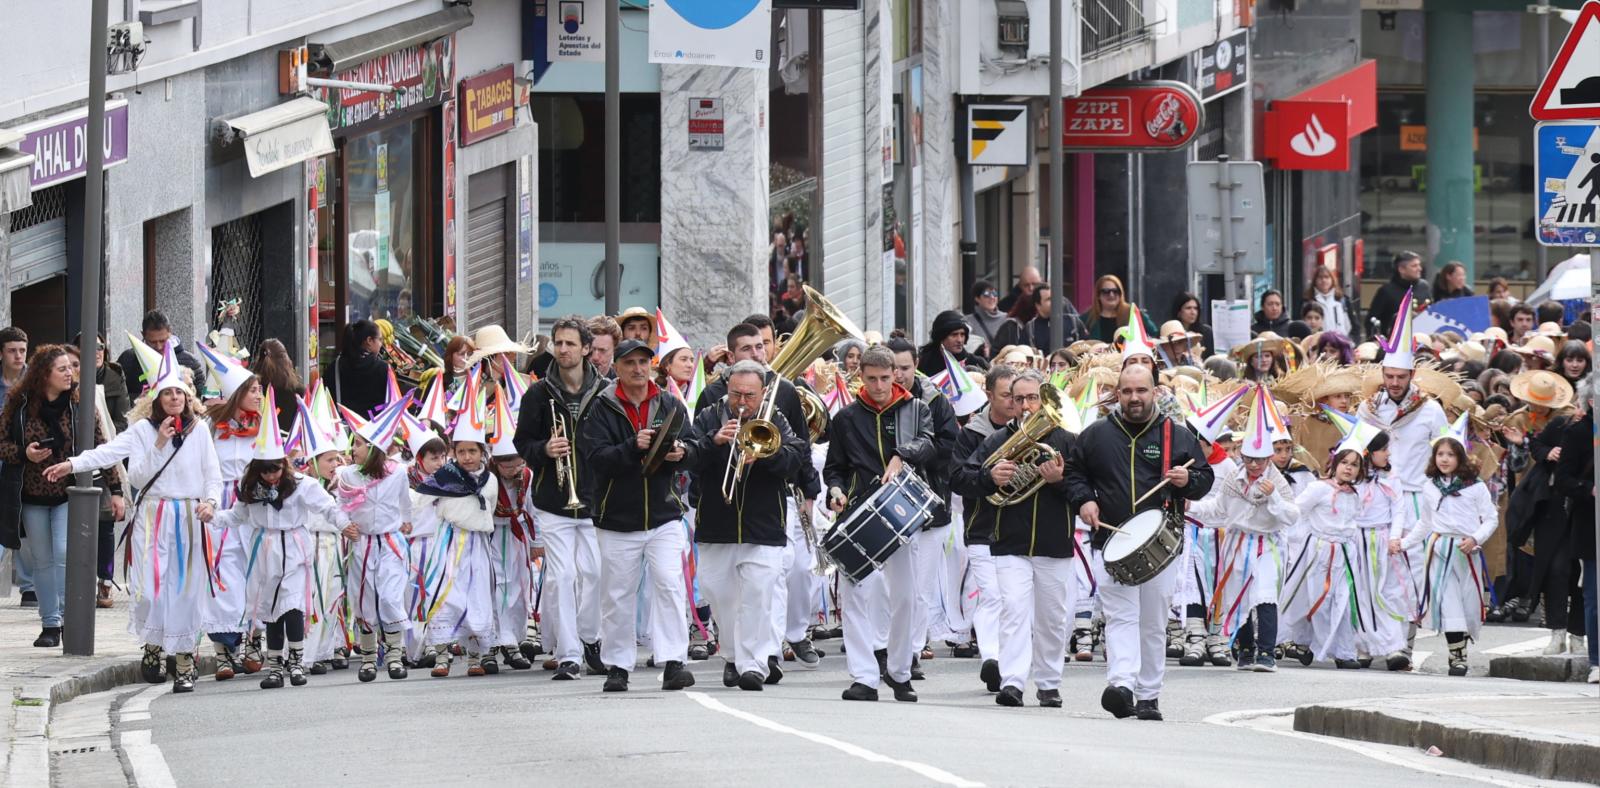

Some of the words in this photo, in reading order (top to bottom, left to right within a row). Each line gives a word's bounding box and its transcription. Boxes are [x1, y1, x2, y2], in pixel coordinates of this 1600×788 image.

[559, 42, 589, 50] Apuestas
[477, 79, 512, 111] TABACOS
[1069, 118, 1124, 131] ZAPE
[34, 129, 71, 181] AHAL
[540, 262, 559, 271] años
